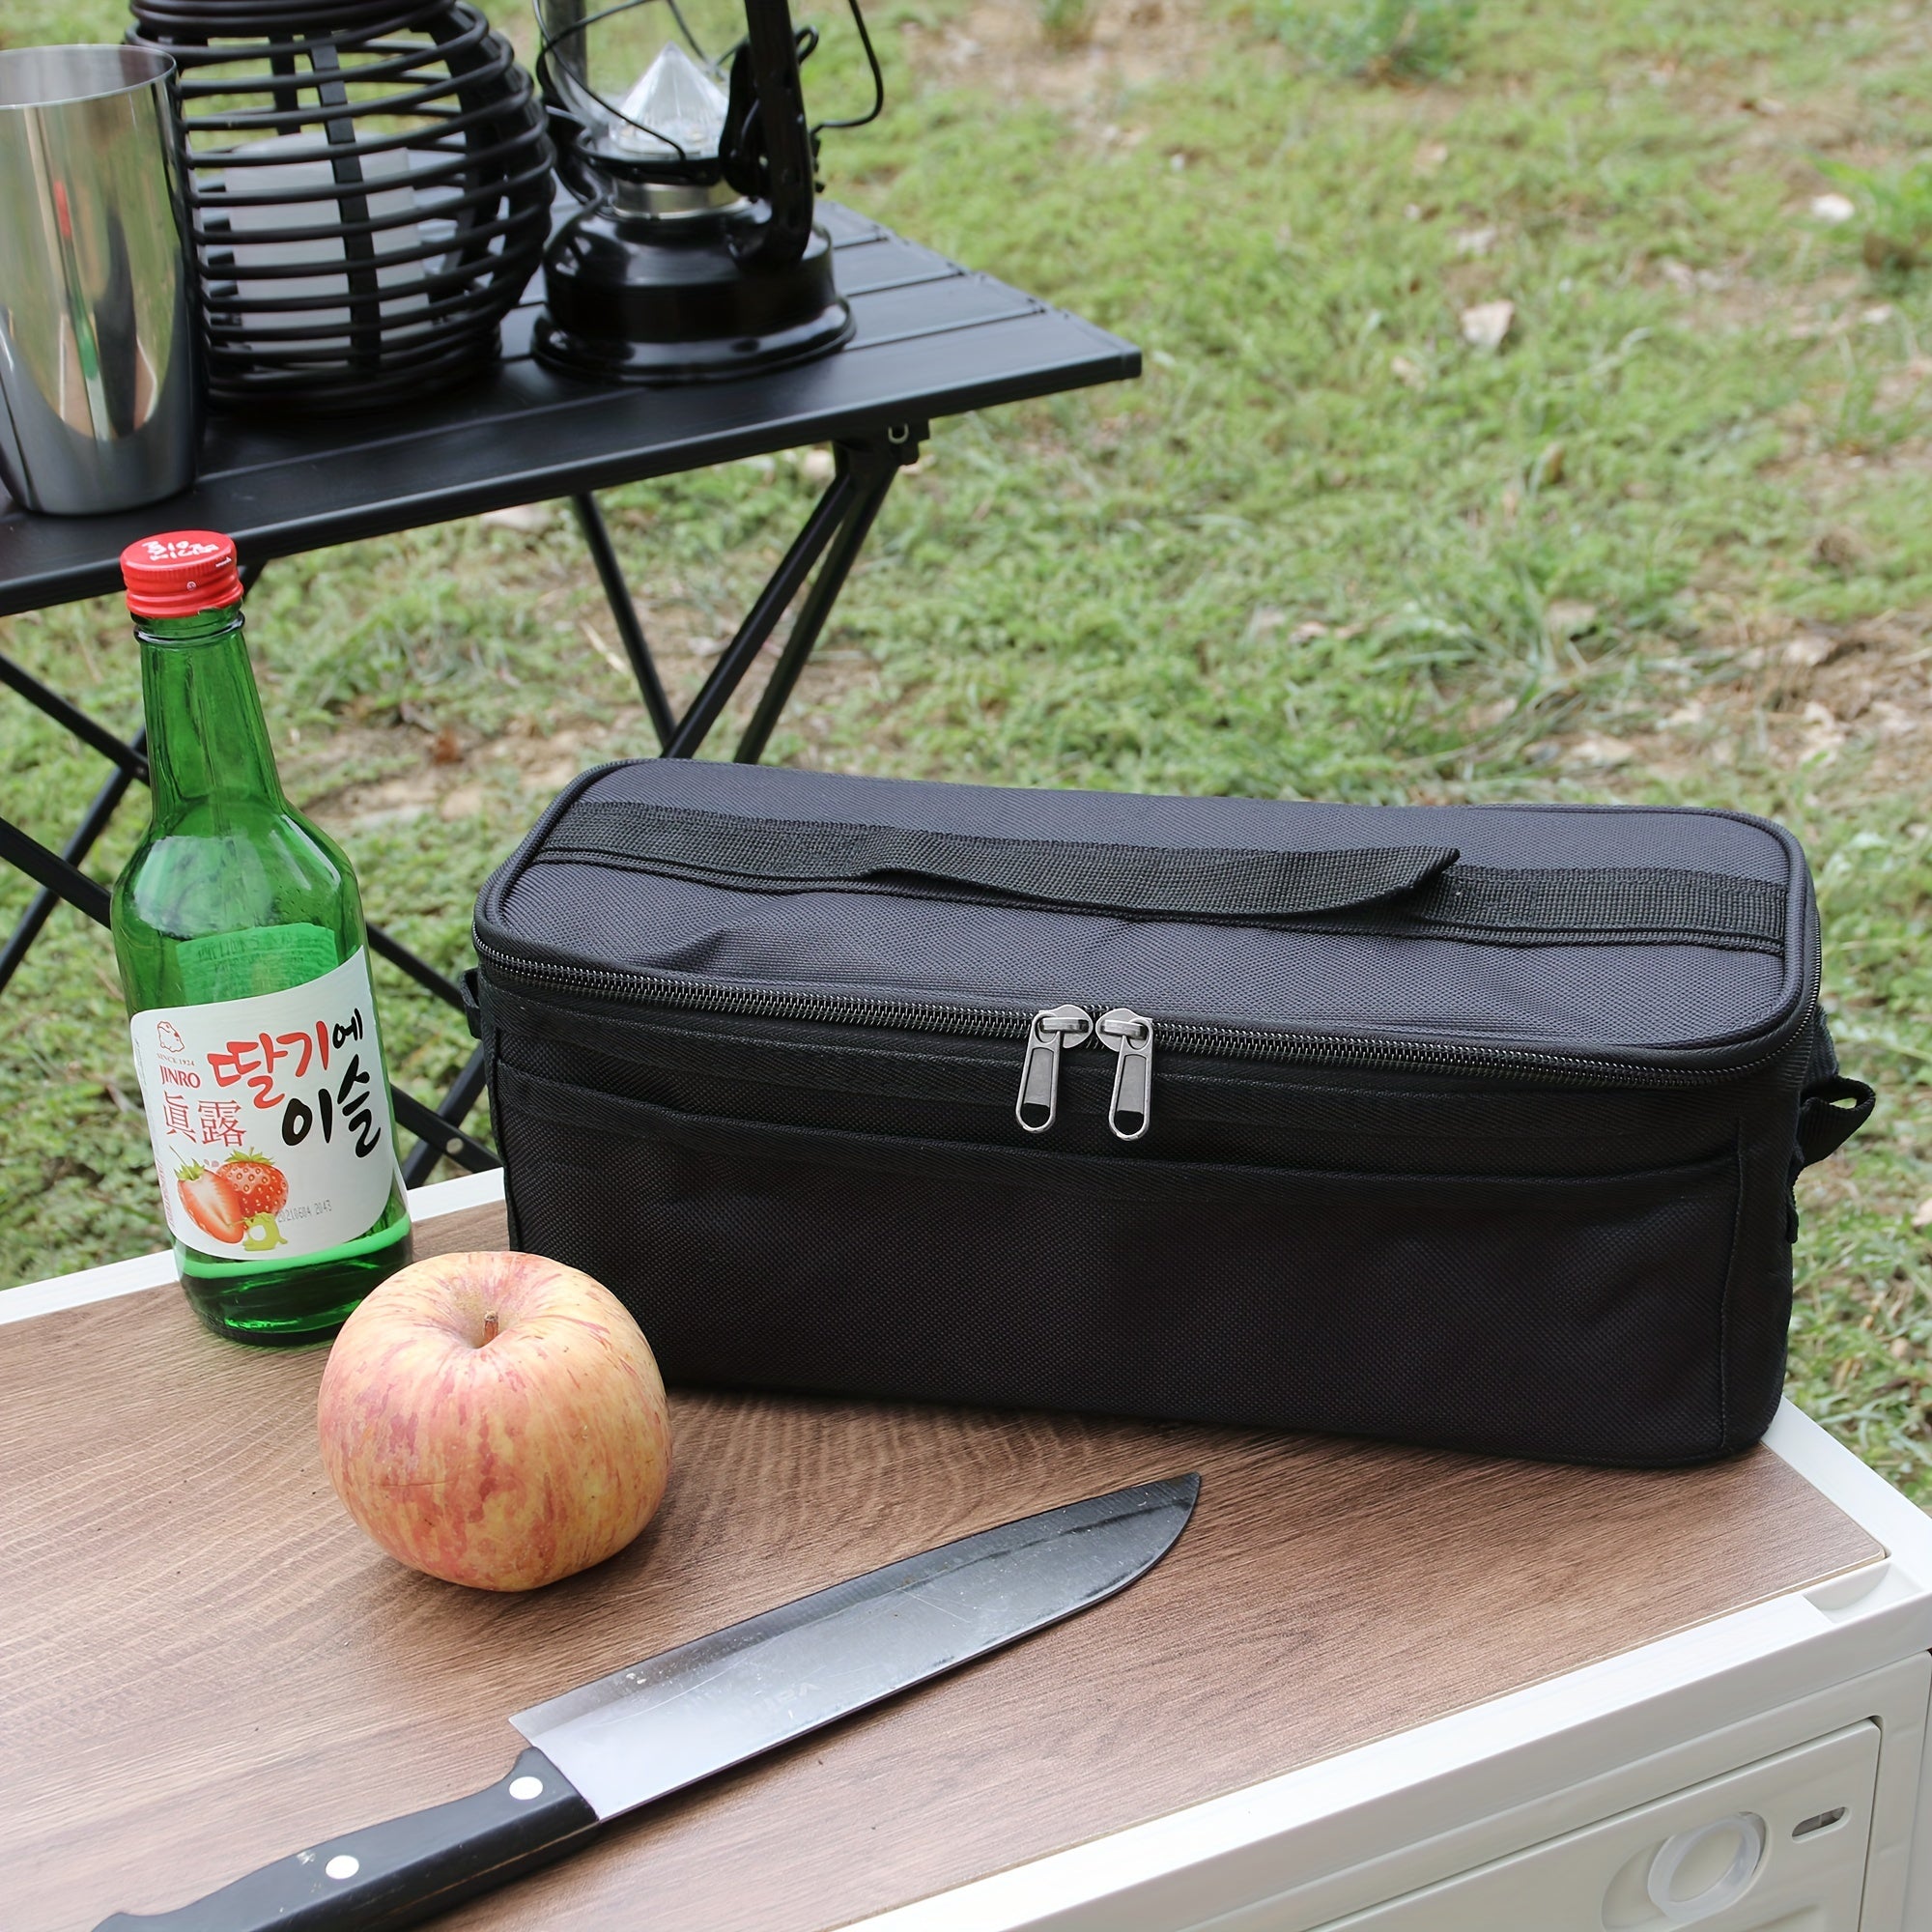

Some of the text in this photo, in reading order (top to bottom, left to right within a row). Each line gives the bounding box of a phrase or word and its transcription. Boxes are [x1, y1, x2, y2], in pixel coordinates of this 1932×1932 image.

[159, 1065, 201, 1089] JINRO
[207, 1009, 364, 1110] 딸기에
[282, 1054, 382, 1158] 이슬
